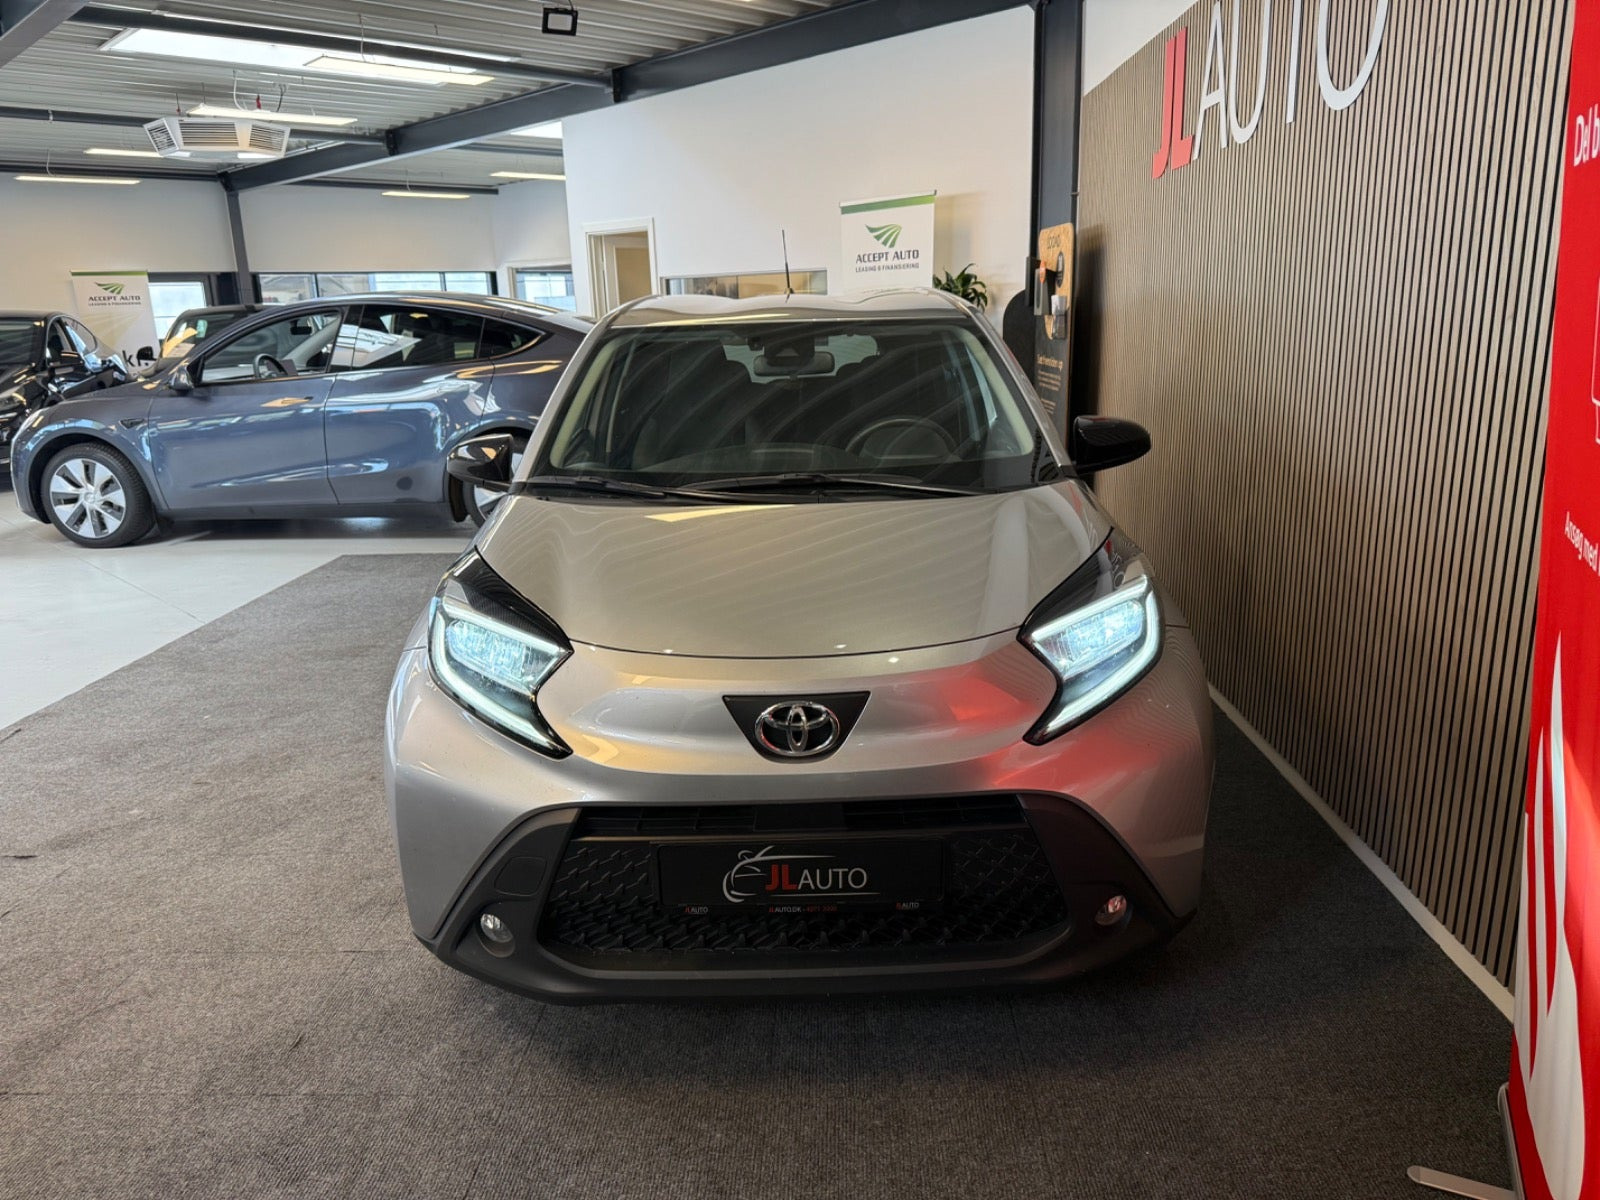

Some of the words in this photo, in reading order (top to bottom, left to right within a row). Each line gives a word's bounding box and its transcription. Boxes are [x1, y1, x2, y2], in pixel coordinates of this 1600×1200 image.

[1573, 106, 1593, 166] Del
[856, 251, 889, 264] ACCEPT
[893, 249, 919, 261] AUTO
[765, 863, 868, 891] JLAUTO
